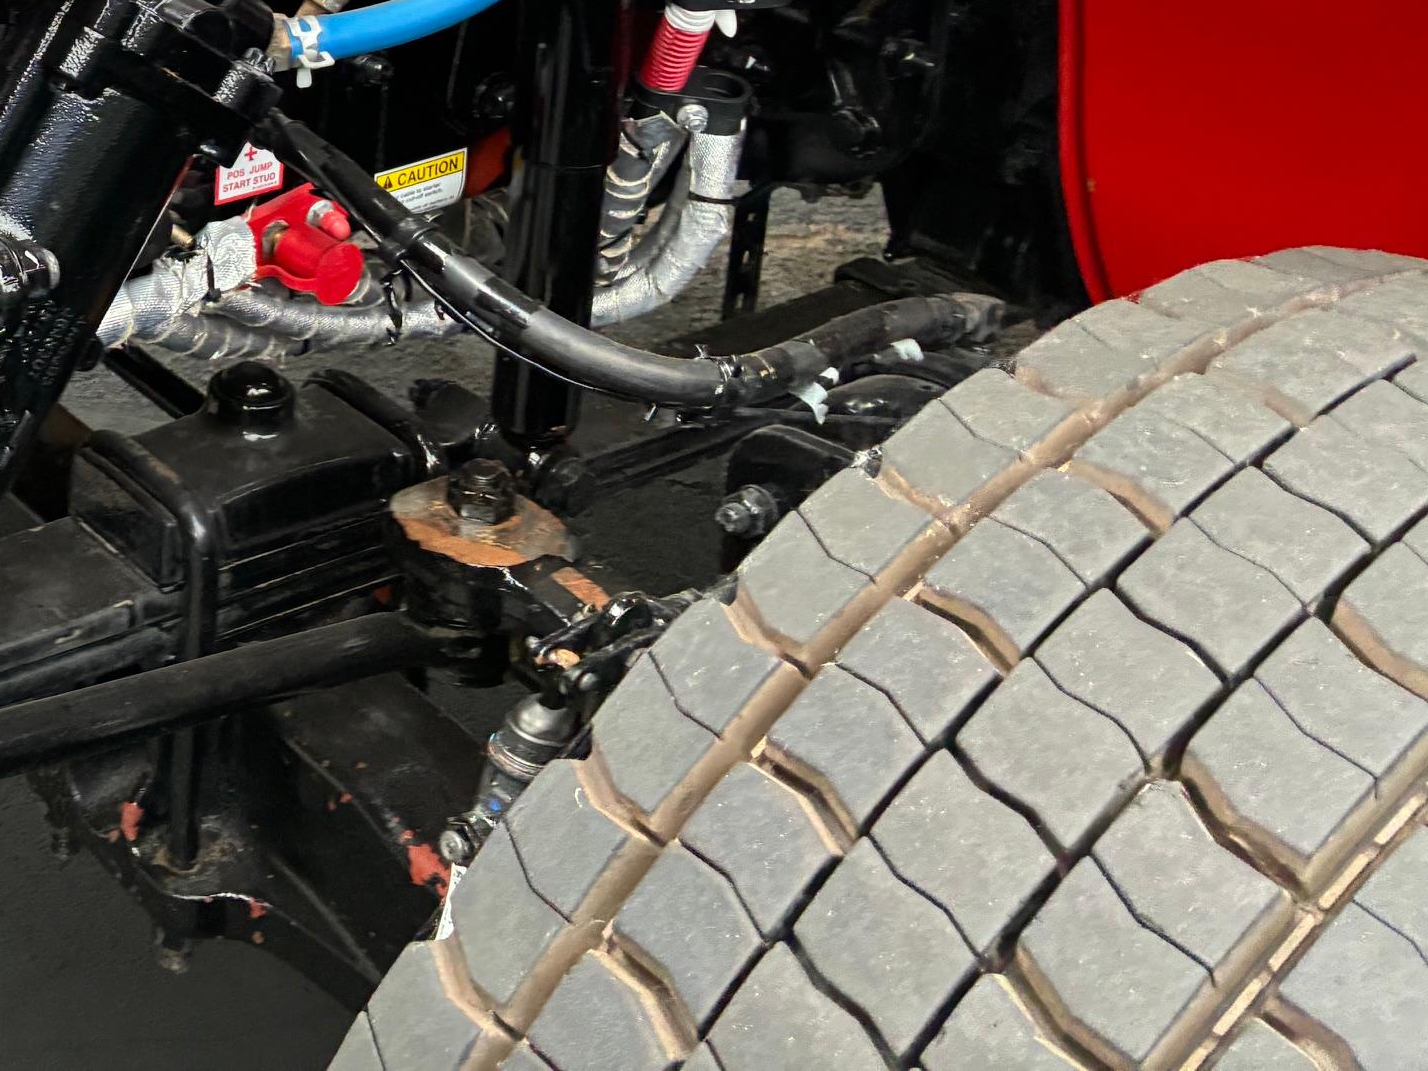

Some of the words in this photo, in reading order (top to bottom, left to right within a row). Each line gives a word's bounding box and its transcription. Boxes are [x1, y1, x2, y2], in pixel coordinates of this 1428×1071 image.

[227, 168, 245, 180] POS
[249, 161, 274, 175] JUMP
[397, 156, 459, 187] CAUTION
[222, 178, 252, 193] START
[253, 172, 276, 185] STUD
